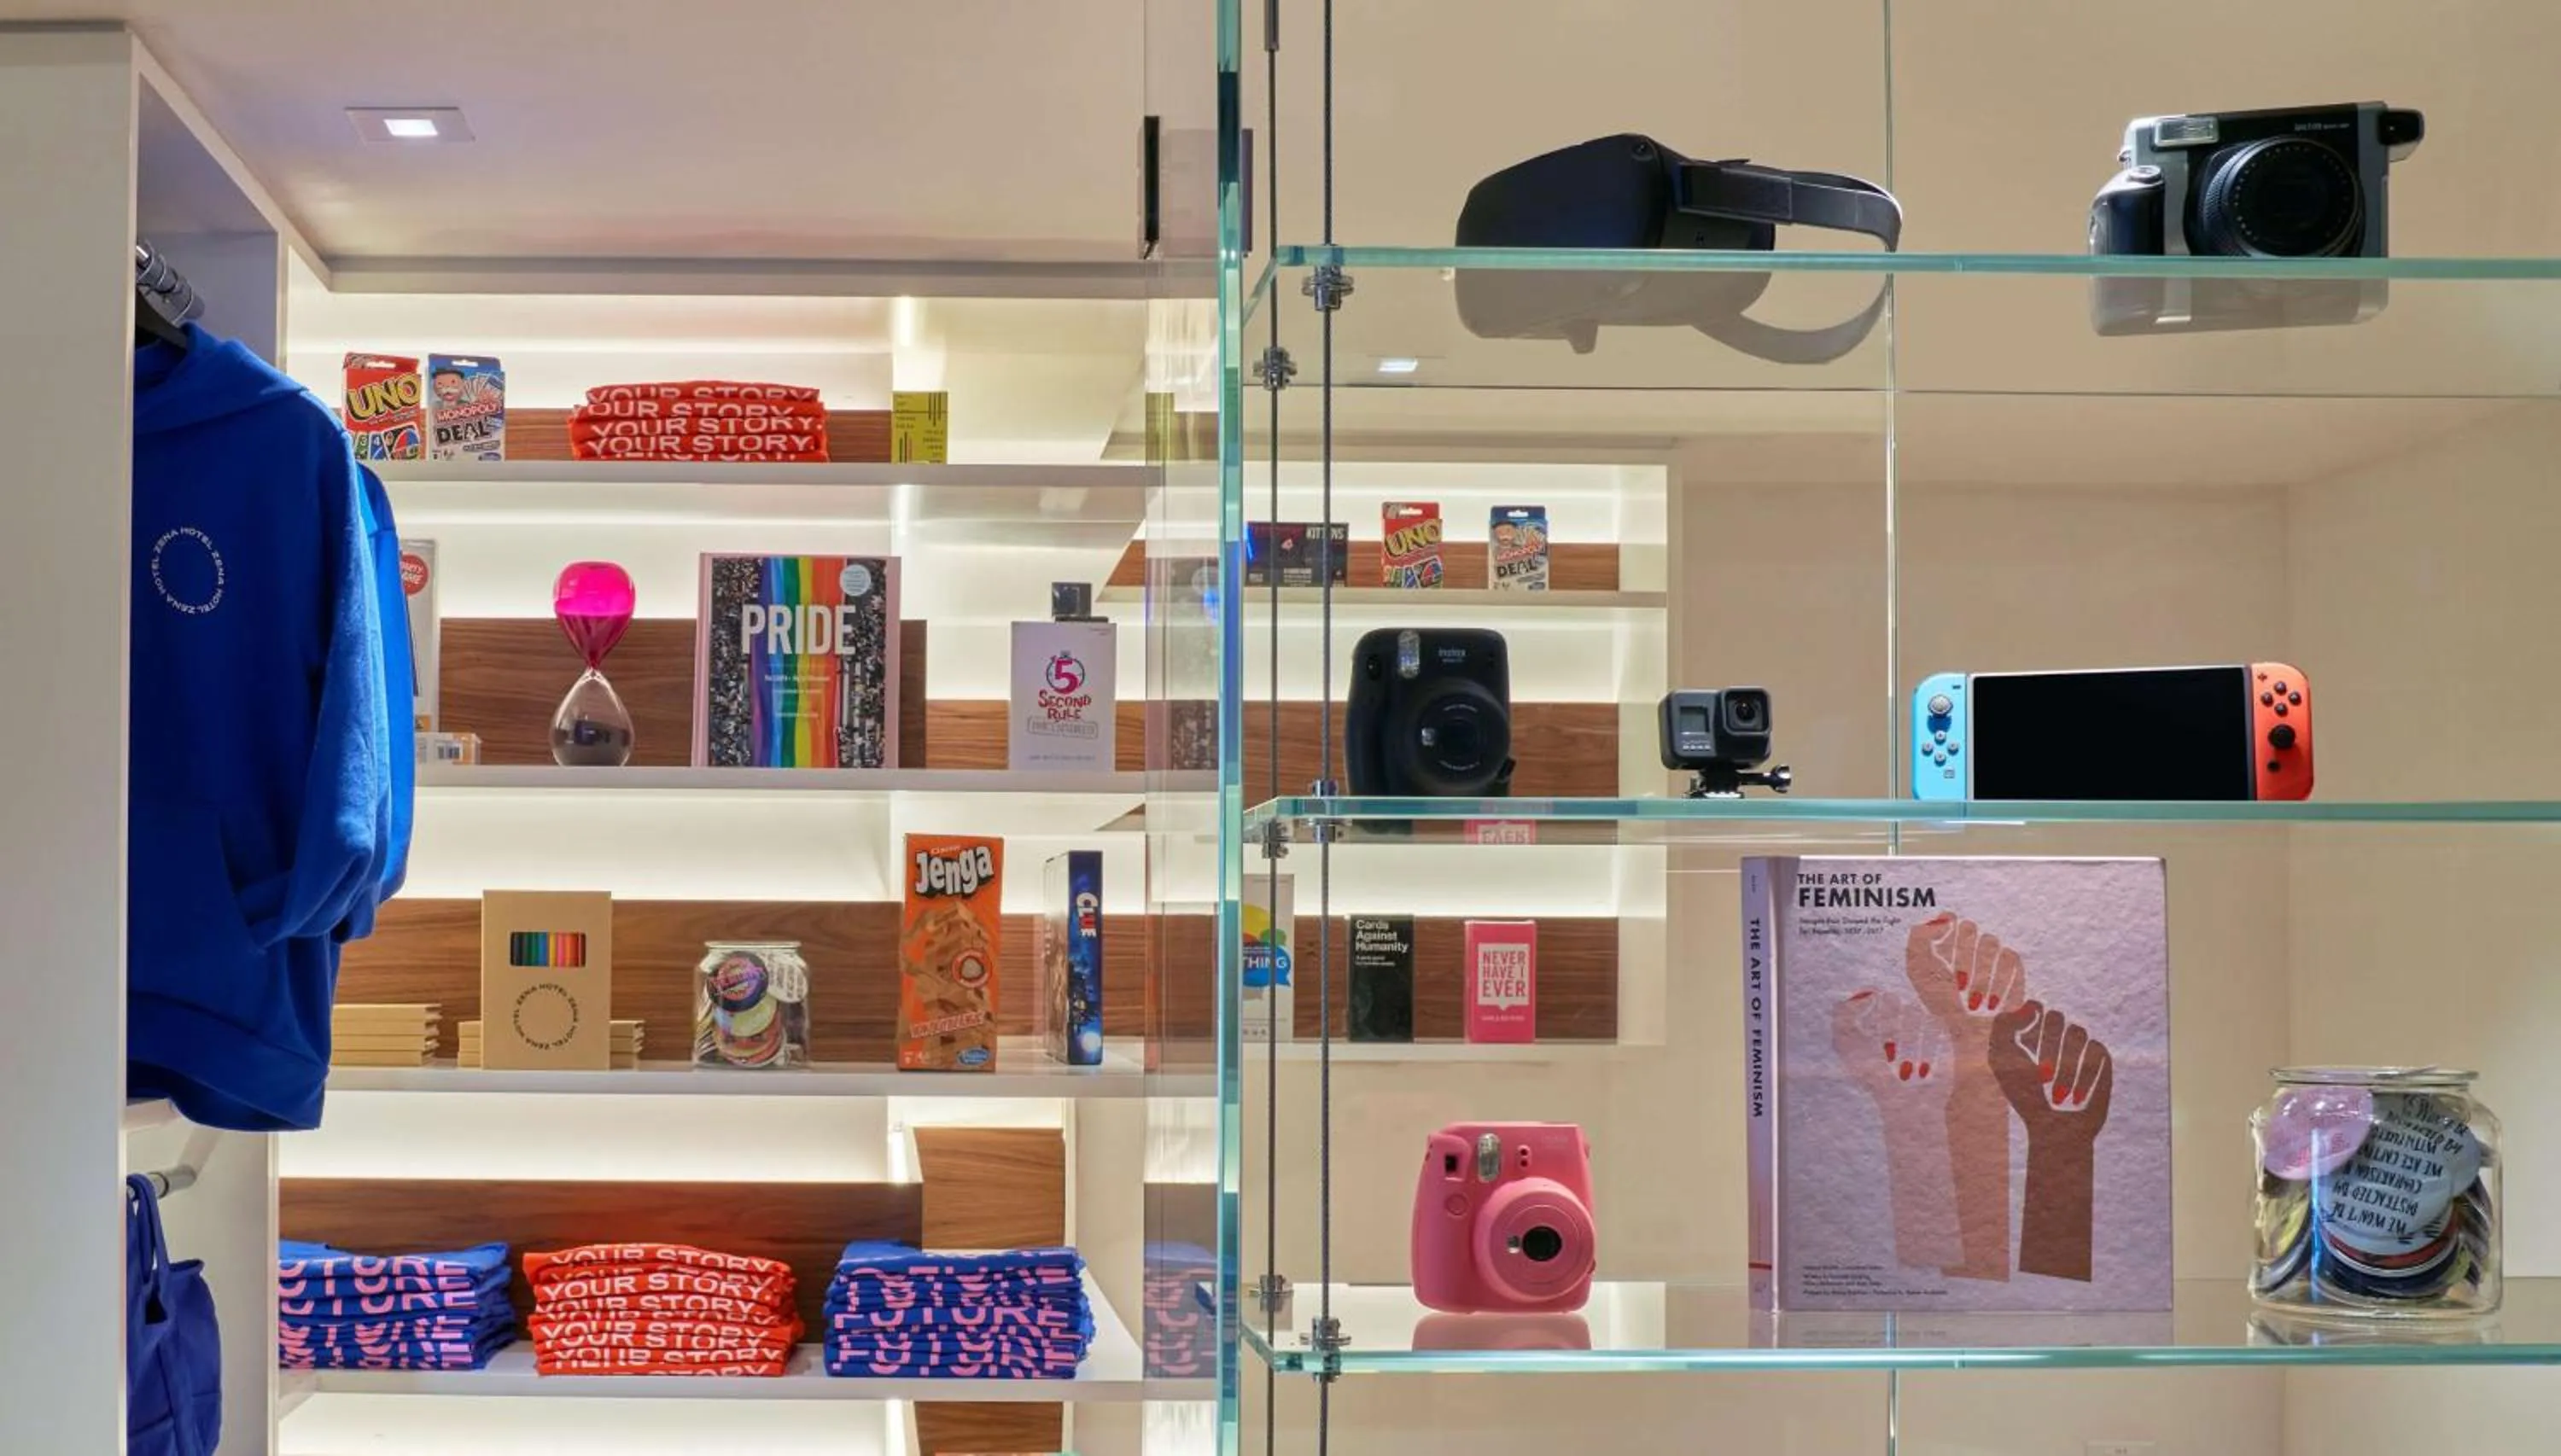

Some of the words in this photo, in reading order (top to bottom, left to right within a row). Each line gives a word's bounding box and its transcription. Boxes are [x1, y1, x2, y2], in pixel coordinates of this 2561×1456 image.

[347, 373, 422, 420] UNO
[436, 401, 499, 422] MONOPOLY
[436, 417, 491, 445] DEAL
[591, 417, 687, 437] YOUR
[586, 435, 681, 455] YOUR
[1306, 526, 1345, 540] KITTNS
[1384, 519, 1443, 557] UNO
[154, 529, 179, 554] ZENA
[180, 527, 213, 550] HOTEL
[211, 550, 225, 585] ZENA
[1497, 559, 1538, 578] DEAL
[740, 603, 857, 655] PRIDE
[1054, 658, 1081, 695] 5
[1037, 689, 1093, 709] SECOND
[1047, 707, 1082, 723] RULE
[914, 846, 995, 895] Jenga
[1797, 873, 1824, 885] THE
[1829, 873, 1857, 885] ART
[1862, 873, 1882, 885] OF
[1798, 887, 1936, 907] FEMINISM
[1076, 892, 1100, 938] CLUE
[1355, 918, 1389, 929] Cards
[1355, 930, 1397, 942] Against
[1749, 917, 1761, 950] THE
[1355, 941, 1409, 953] Humanity
[1482, 951, 1526, 965] NEVER
[1482, 965, 1514, 979] HAVE
[1518, 965, 1526, 979] I
[1750, 957, 1762, 990] ART
[1482, 981, 1526, 999] EVER
[1751, 997, 1763, 1021] OF
[1752, 1028, 1764, 1118] FEMINISM
[2352, 1186, 2419, 1217] DISTRACTED
[542, 1276, 636, 1301] YOUR
[535, 1296, 627, 1313] YOUR
